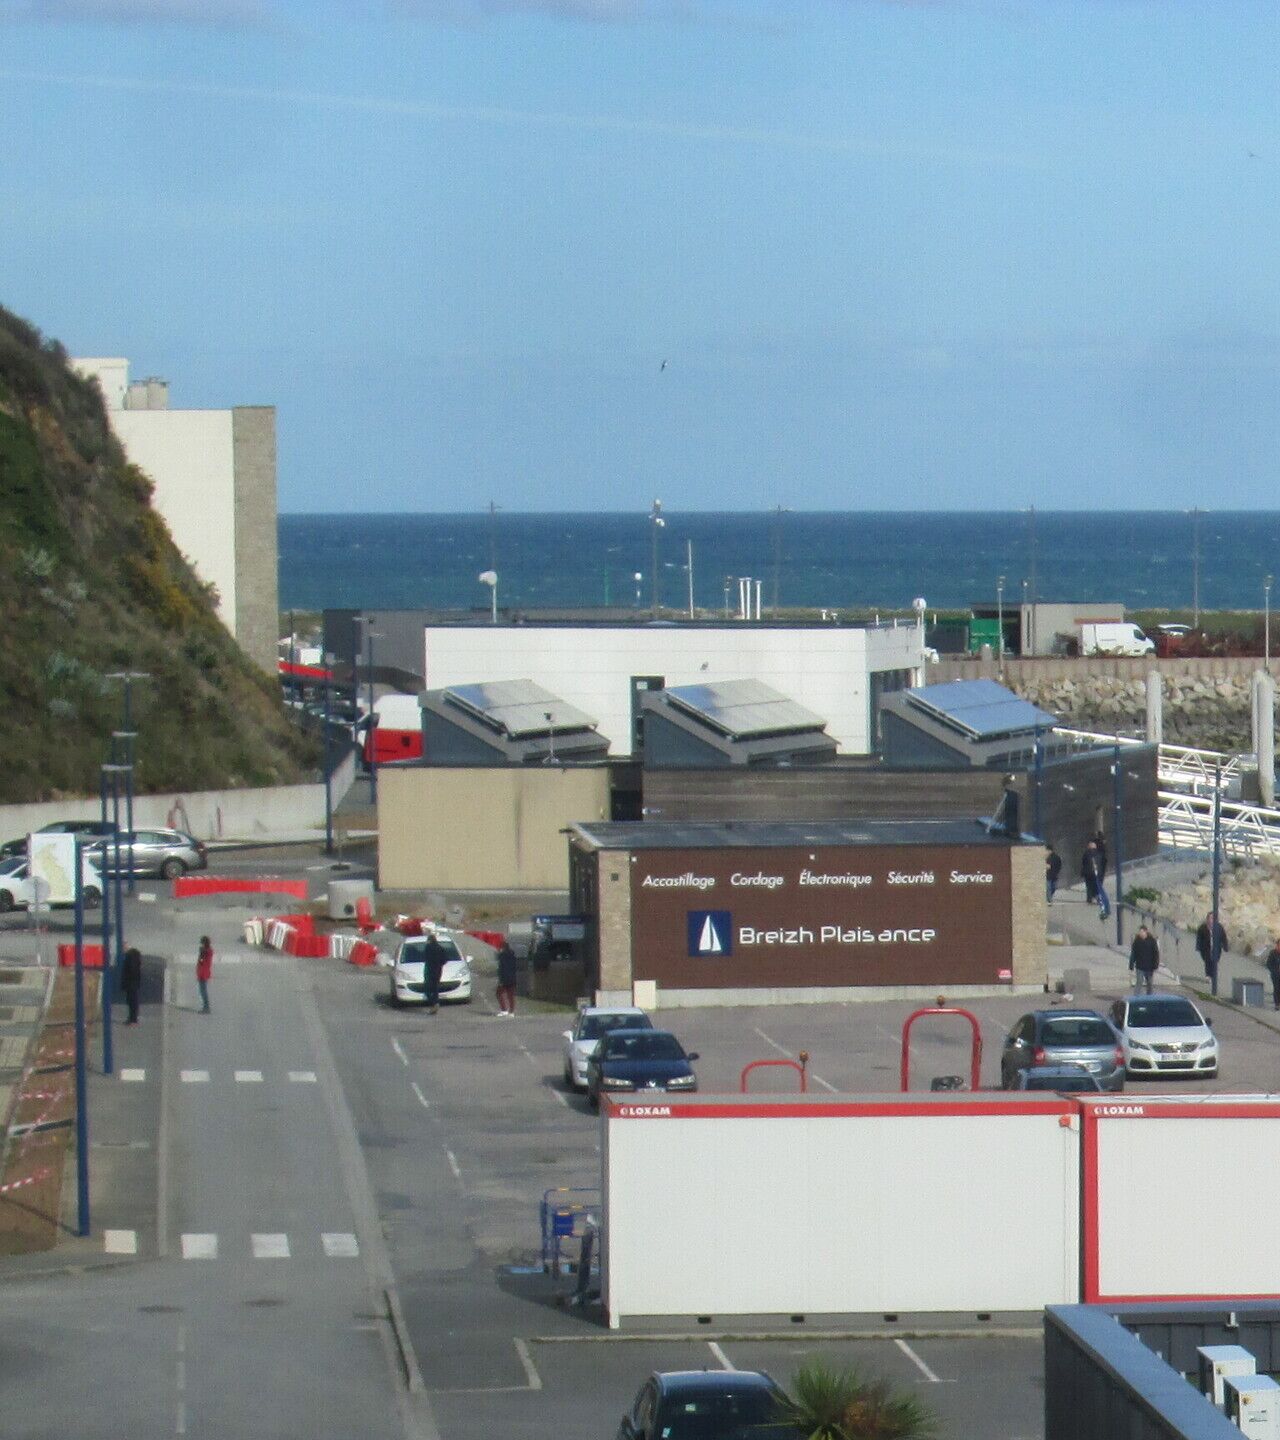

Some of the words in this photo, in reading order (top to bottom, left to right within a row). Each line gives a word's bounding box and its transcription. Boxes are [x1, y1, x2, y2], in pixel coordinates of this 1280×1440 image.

[642, 873, 715, 891] Accastillage
[731, 872, 784, 890] Cordage
[799, 869, 872, 888] Électronique
[887, 869, 935, 885] Sécurité
[949, 870, 993, 884] Service
[739, 925, 813, 945] Breizh
[820, 924, 935, 944] Plaisance
[629, 1106, 670, 1116] LOXAM
[1103, 1105, 1144, 1115] LOXAM
